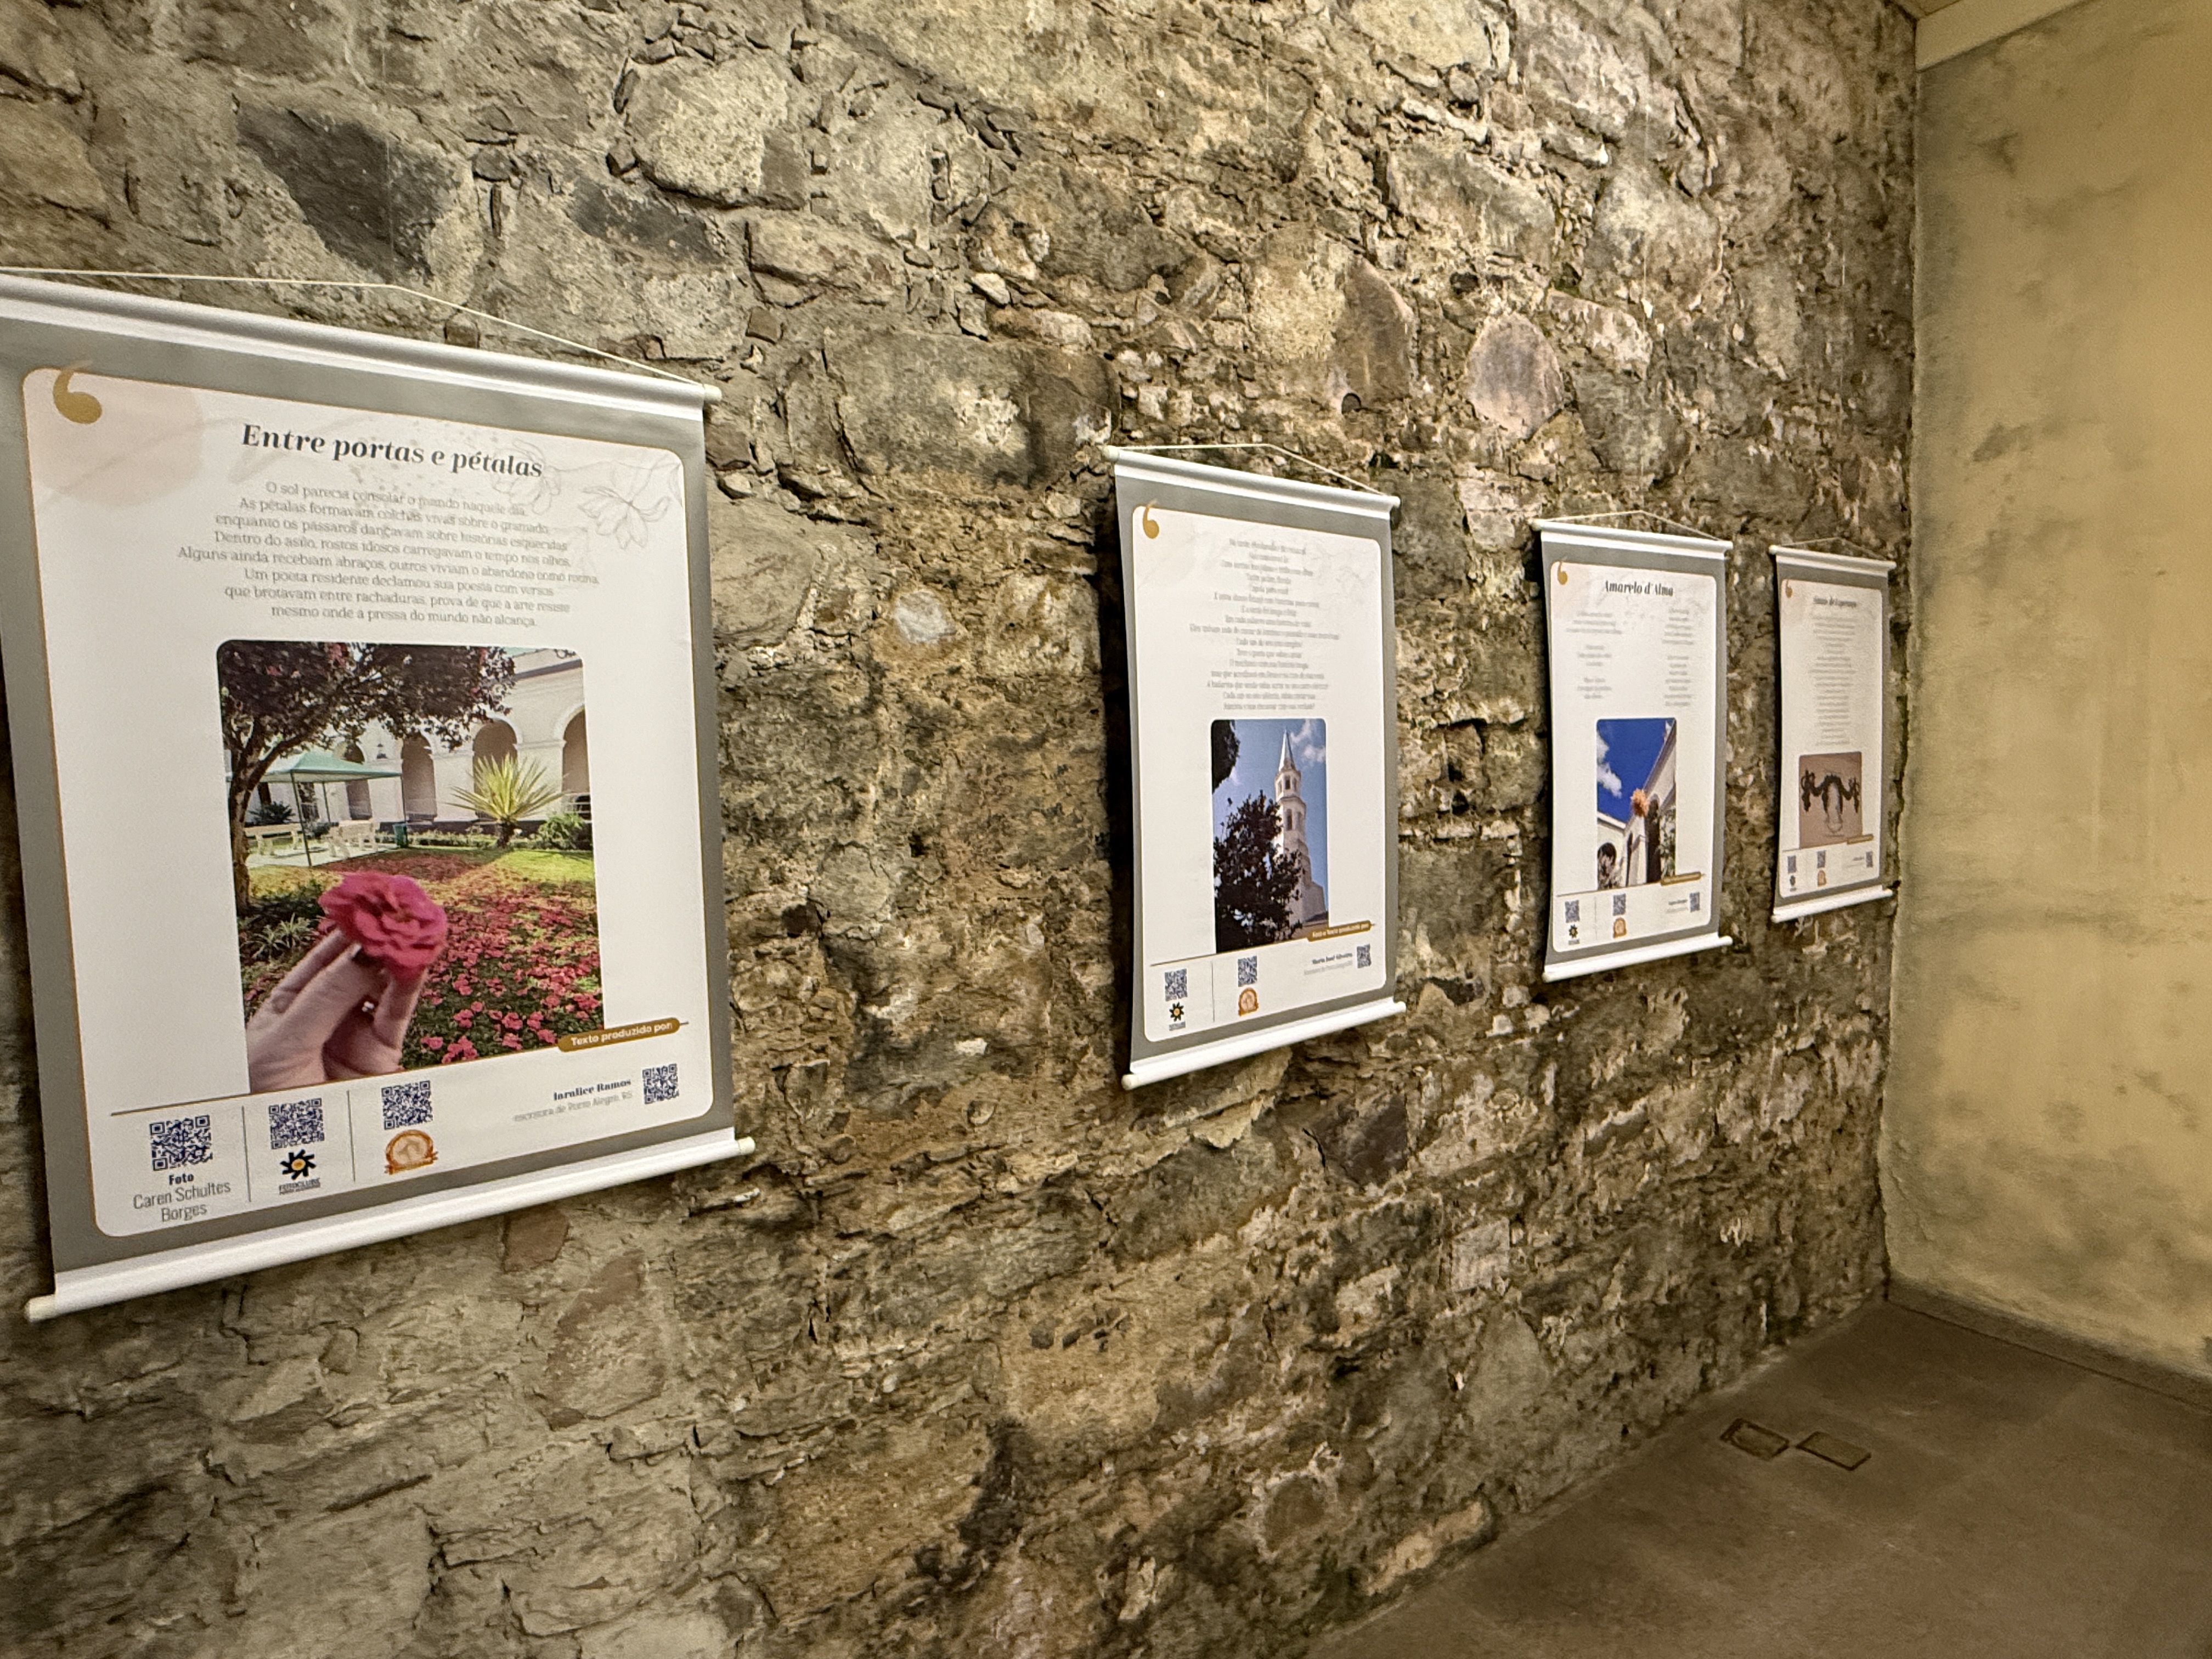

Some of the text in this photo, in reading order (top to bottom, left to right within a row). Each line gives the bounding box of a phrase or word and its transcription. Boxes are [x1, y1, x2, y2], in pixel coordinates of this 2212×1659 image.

[241, 424, 542, 477] Entre portas e pétalas
[265, 481, 276, 493] O
[280, 483, 298, 494] sol
[302, 487, 349, 499] parecia
[407, 496, 415, 505] o
[419, 496, 459, 509] mundo
[240, 498, 257, 510] As
[259, 500, 306, 512] pétalas
[310, 501, 374, 517] formavam
[458, 517, 488, 528] sobre
[491, 520, 498, 529] o
[216, 515, 280, 529] enquanto
[283, 520, 298, 530] os
[301, 521, 357, 534] pássaros
[360, 524, 422, 538] dançavam
[426, 530, 457, 541] sobre
[214, 531, 261, 545] Dentro
[264, 534, 281, 547] do
[320, 539, 357, 550] rostos
[362, 540, 400, 554] idosos
[403, 545, 472, 559] carregavam
[484, 551, 518, 565] tempo
[521, 555, 539, 565] nos
[177, 546, 227, 562] Alguns
[230, 551, 268, 562] ainda
[272, 554, 332, 566] recebiam
[389, 561, 426, 572] outros
[429, 564, 469, 574] viviam
[481, 566, 534, 579] abandono
[537, 572, 565, 581] como
[244, 567, 554, 596] Um poeta residente declamou sua poesia com versos
[224, 586, 250, 600] que
[253, 585, 316, 600] brotavam
[319, 591, 352, 601] entre
[430, 596, 462, 608] prova
[465, 596, 478, 607] de
[481, 599, 500, 611] que
[505, 600, 511, 609] a
[514, 601, 534, 611] arte
[537, 603, 570, 612] resiste
[271, 607, 319, 617] mesmo
[322, 607, 354, 618] onde
[357, 610, 364, 619] a
[368, 610, 407, 622] pressa
[410, 609, 425, 621] do
[428, 612, 468, 623] mundo
[472, 613, 492, 624] não
[571, 1034, 599, 1046] Texto
[601, 1025, 652, 1042] produzido
[169, 1173, 194, 1186] Foto
[133, 1182, 231, 1209] Caren Schultes
[161, 1204, 207, 1222] Borges
